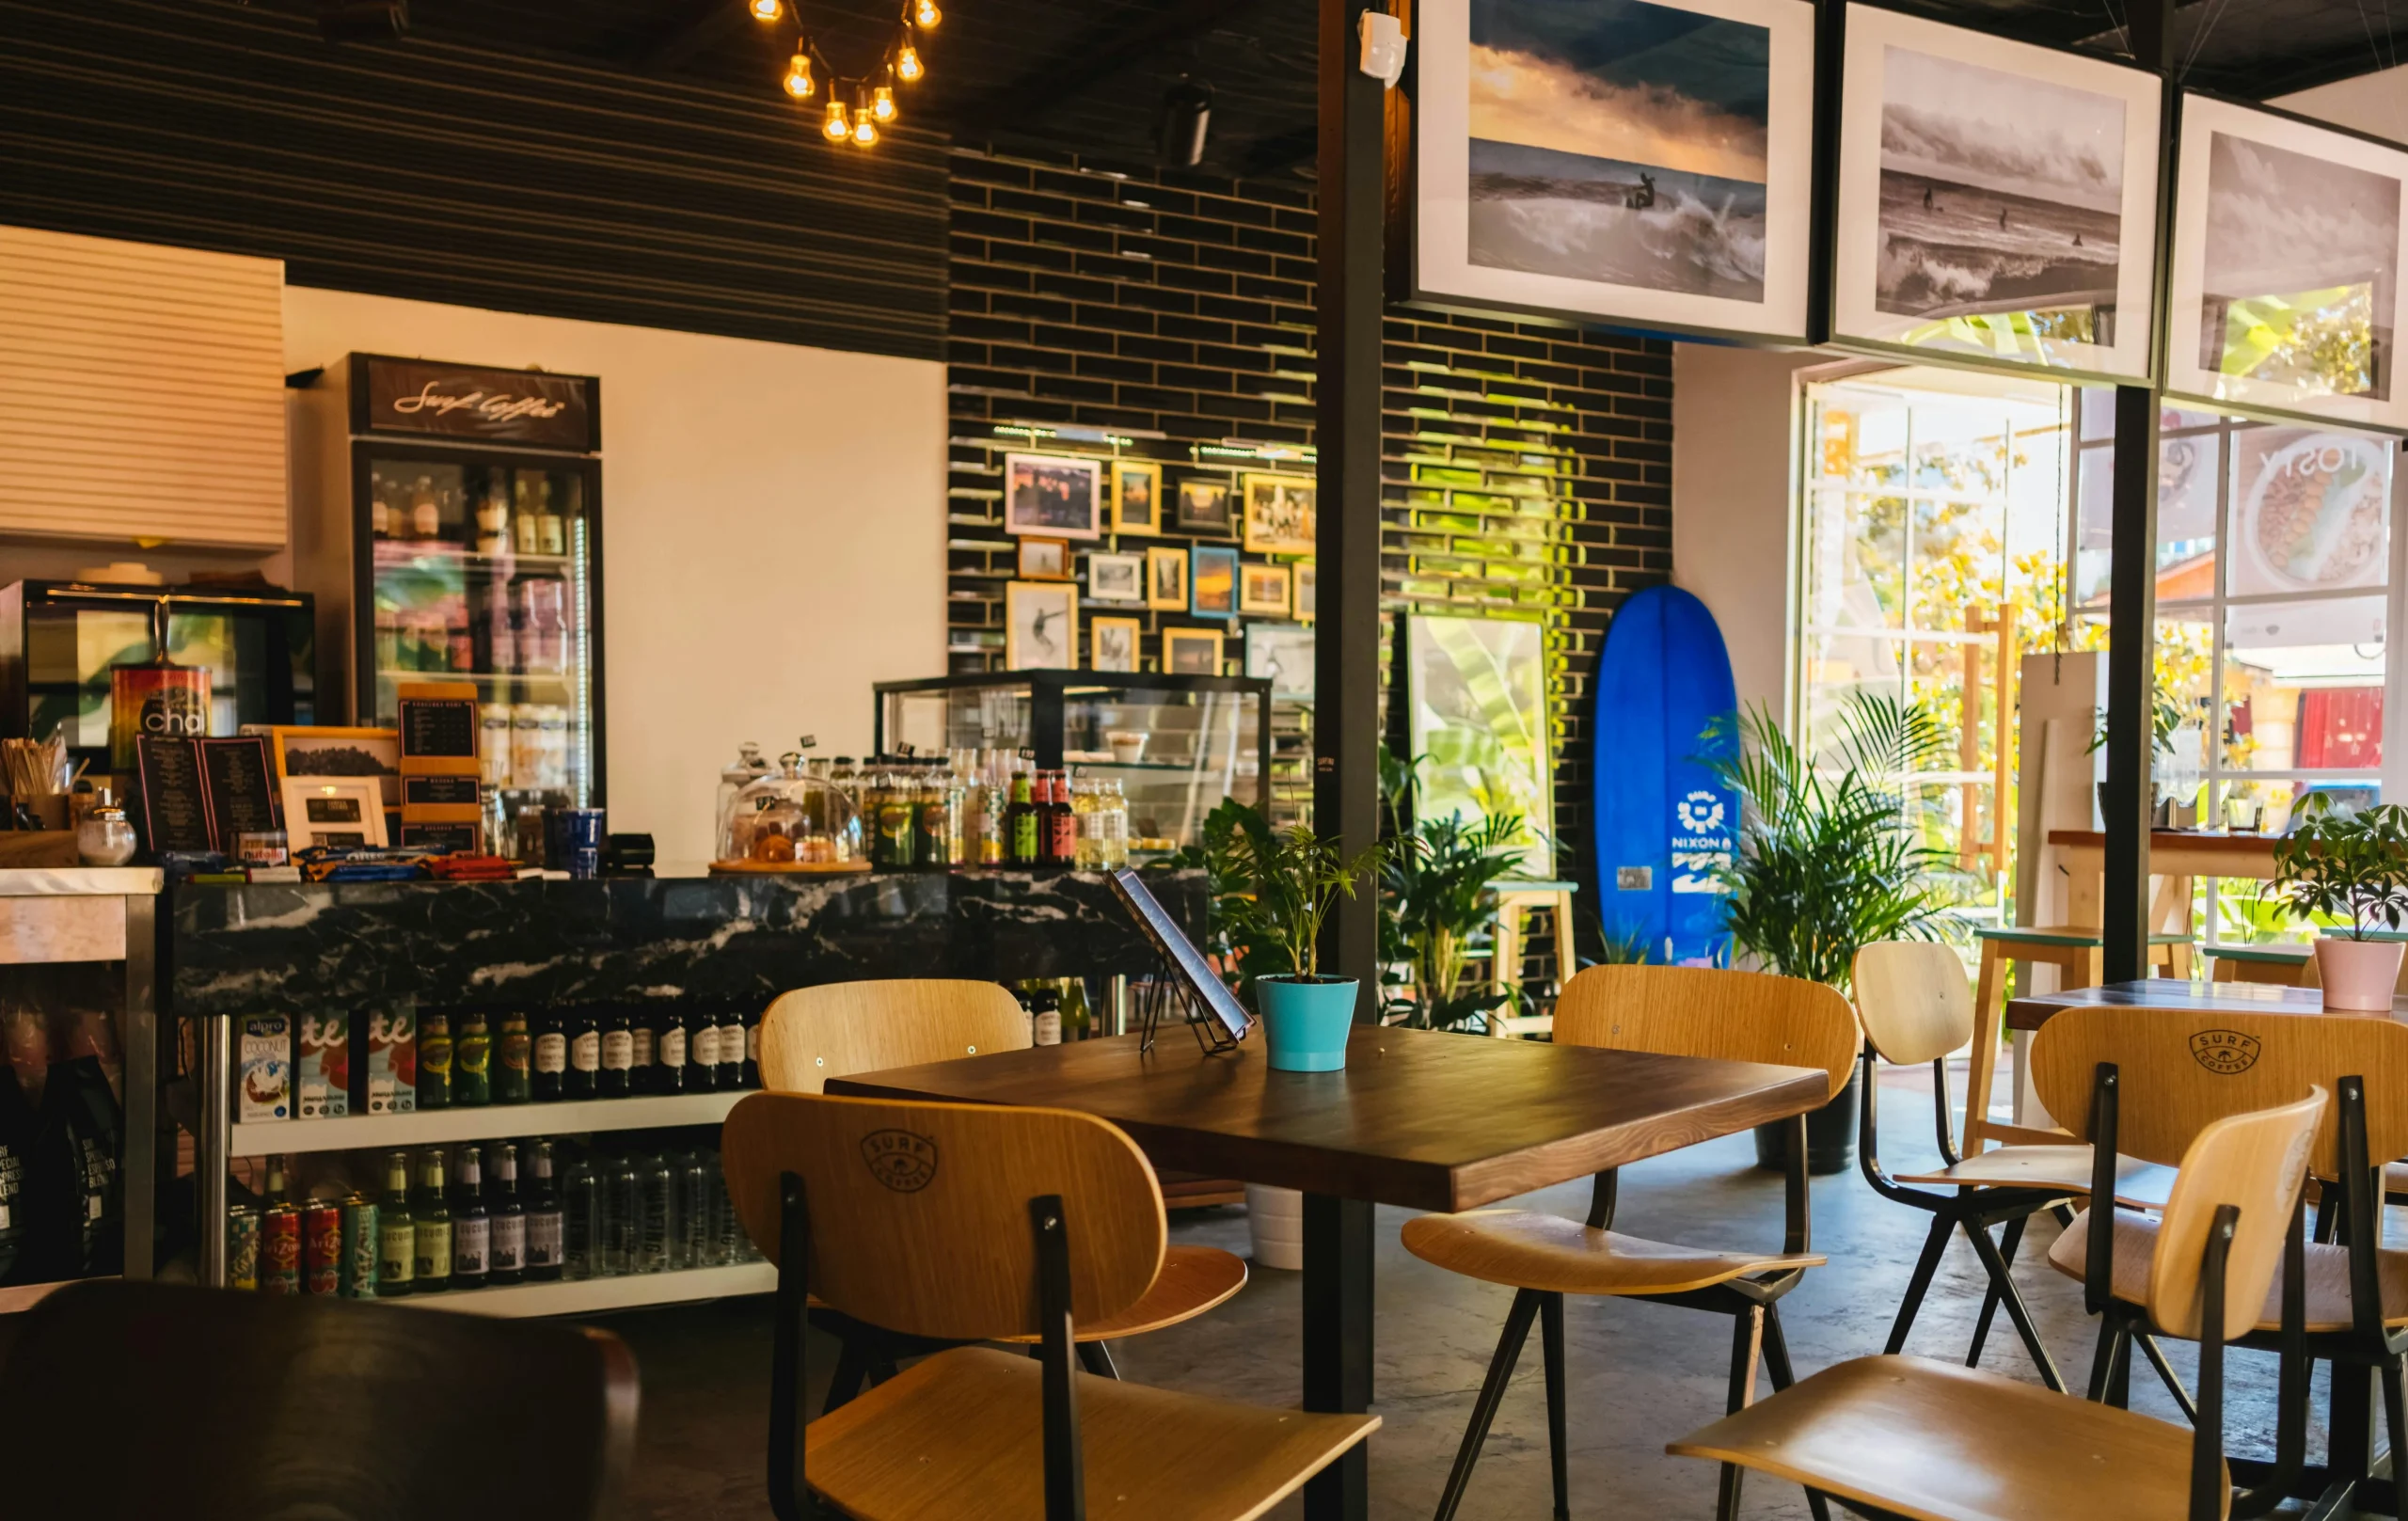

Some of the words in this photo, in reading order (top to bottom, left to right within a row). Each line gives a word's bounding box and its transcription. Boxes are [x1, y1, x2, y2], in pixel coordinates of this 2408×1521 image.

[393, 381, 483, 417] Surf
[1671, 837, 1719, 848] NIXON
[248, 1021, 283, 1033] alpro
[244, 1038, 288, 1054] COCONUT
[2199, 1034, 2252, 1049] SURF
[2201, 1054, 2249, 1071] COFFEE
[870, 1135, 926, 1153] SURF
